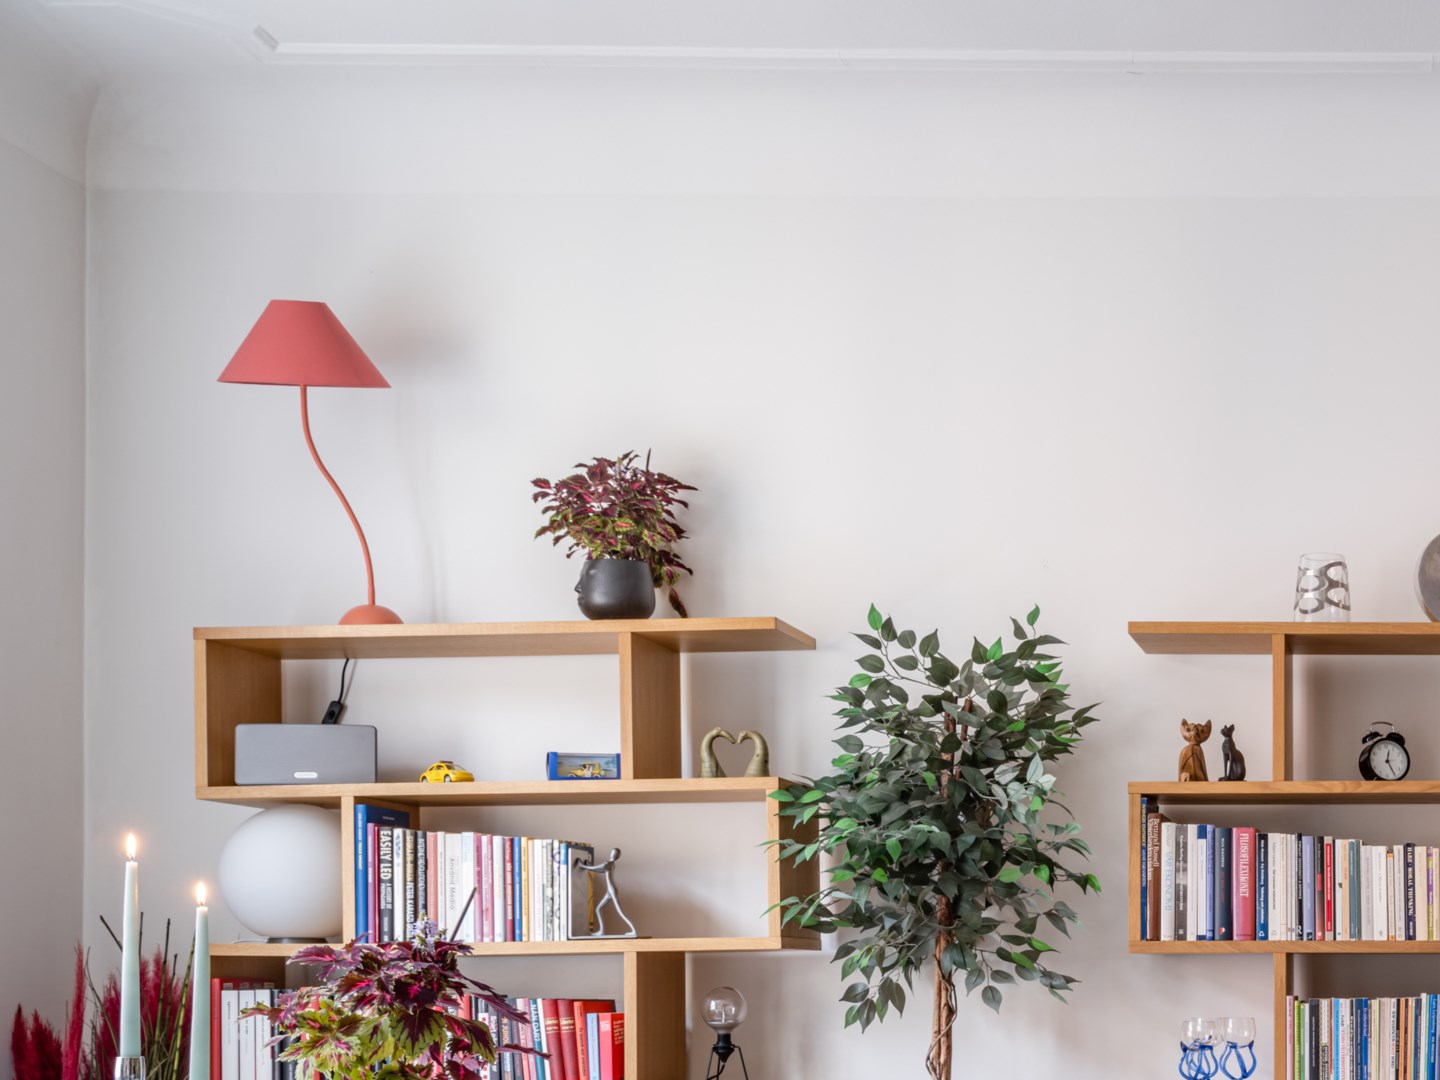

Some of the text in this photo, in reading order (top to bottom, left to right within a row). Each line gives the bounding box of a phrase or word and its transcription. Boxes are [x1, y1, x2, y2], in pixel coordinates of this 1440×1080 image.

[380, 830, 392, 880] EASILY LED
[1240, 834, 1249, 897] FILOSOFILEXIKONET
